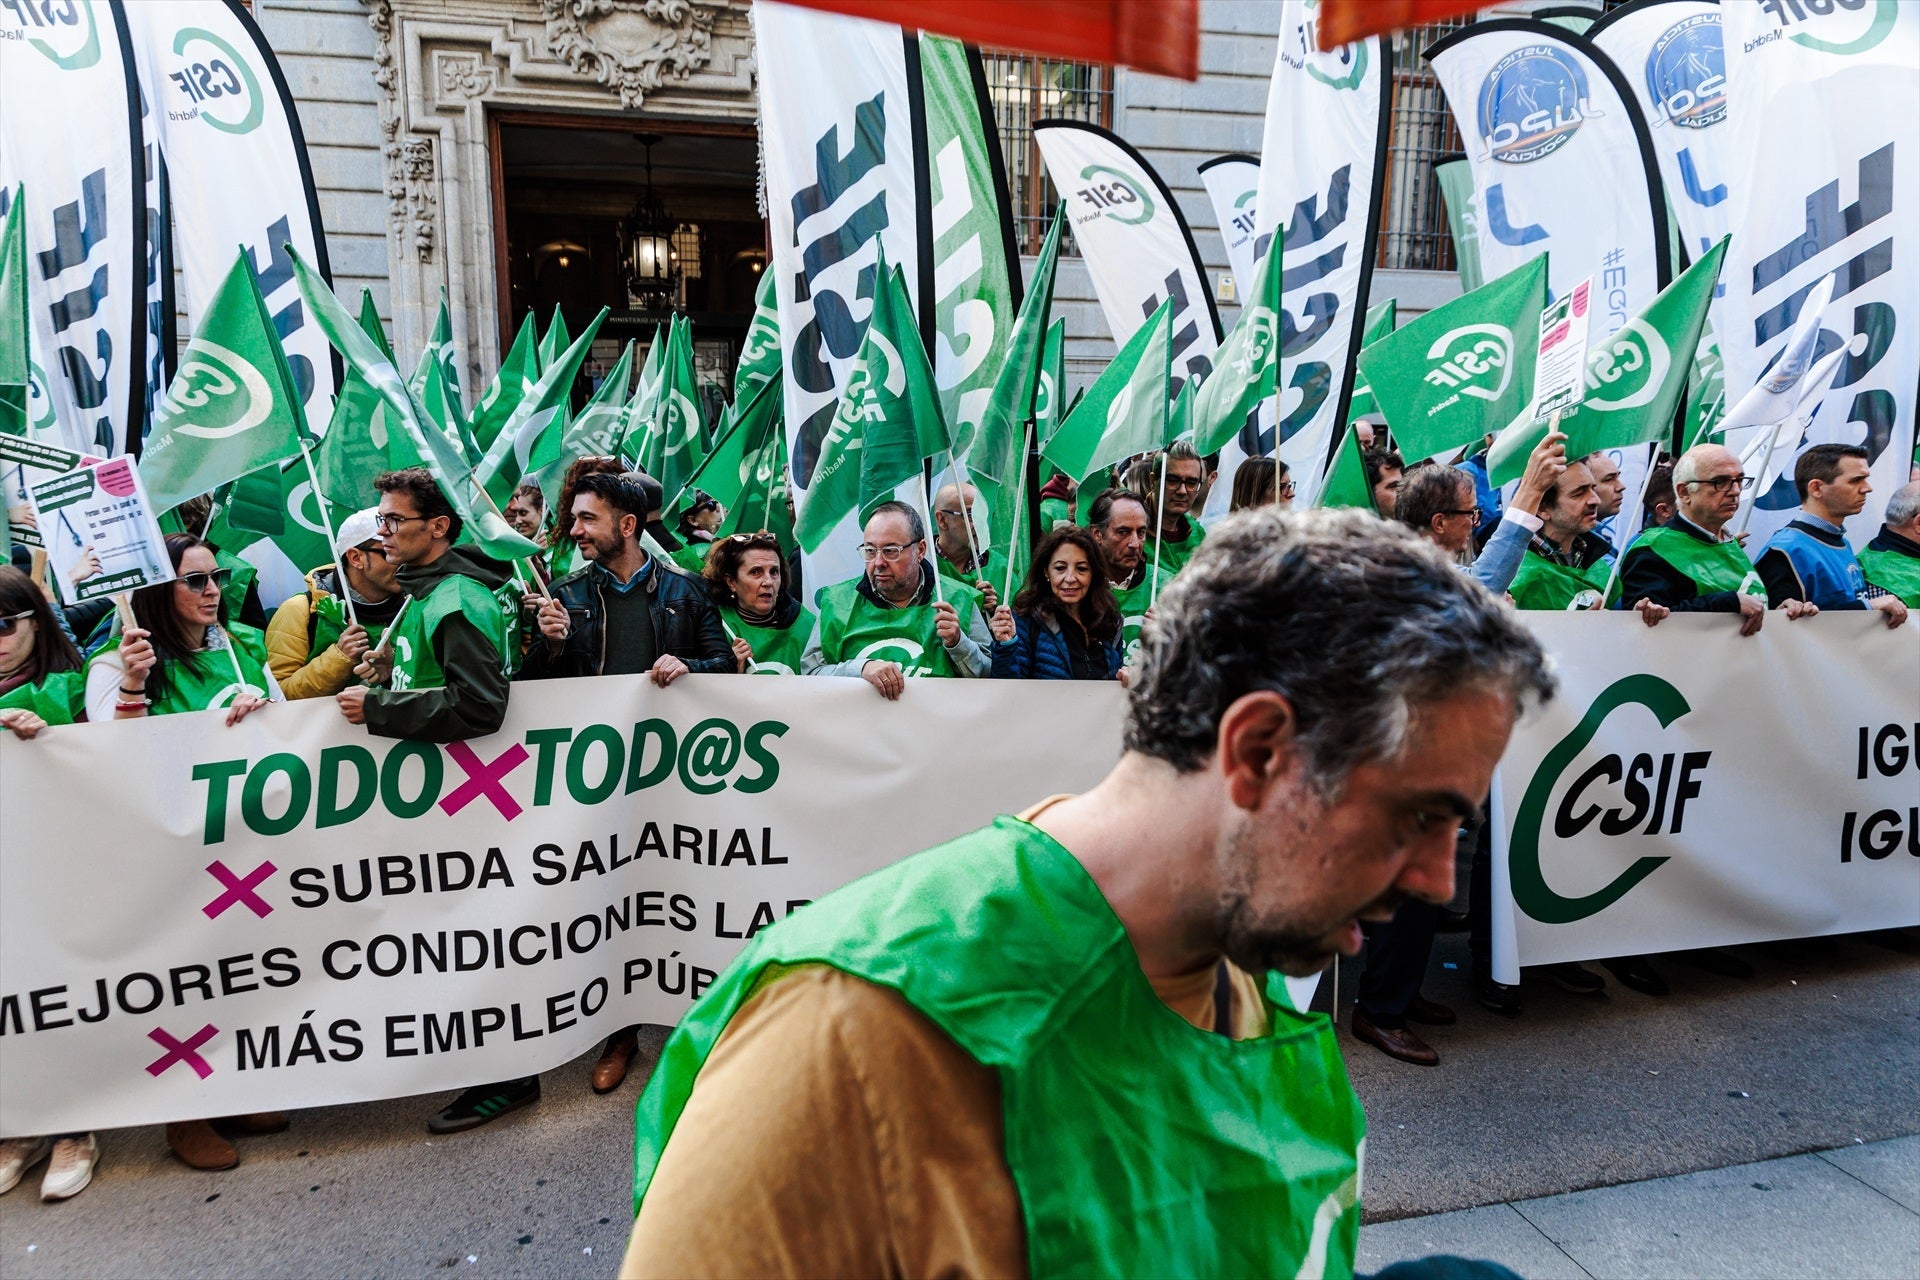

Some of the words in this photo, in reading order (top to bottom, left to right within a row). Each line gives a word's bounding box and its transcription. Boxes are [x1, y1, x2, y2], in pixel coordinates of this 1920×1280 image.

[1554, 750, 1712, 839] CSIF
[1856, 722, 1920, 780] IG
[289, 846, 515, 908] SUBIDA
[532, 821, 789, 886] SALARIAL
[321, 890, 697, 981] CONDICIONES
[235, 1009, 364, 1072] MÁS
[385, 976, 609, 1058] EMPLEO
